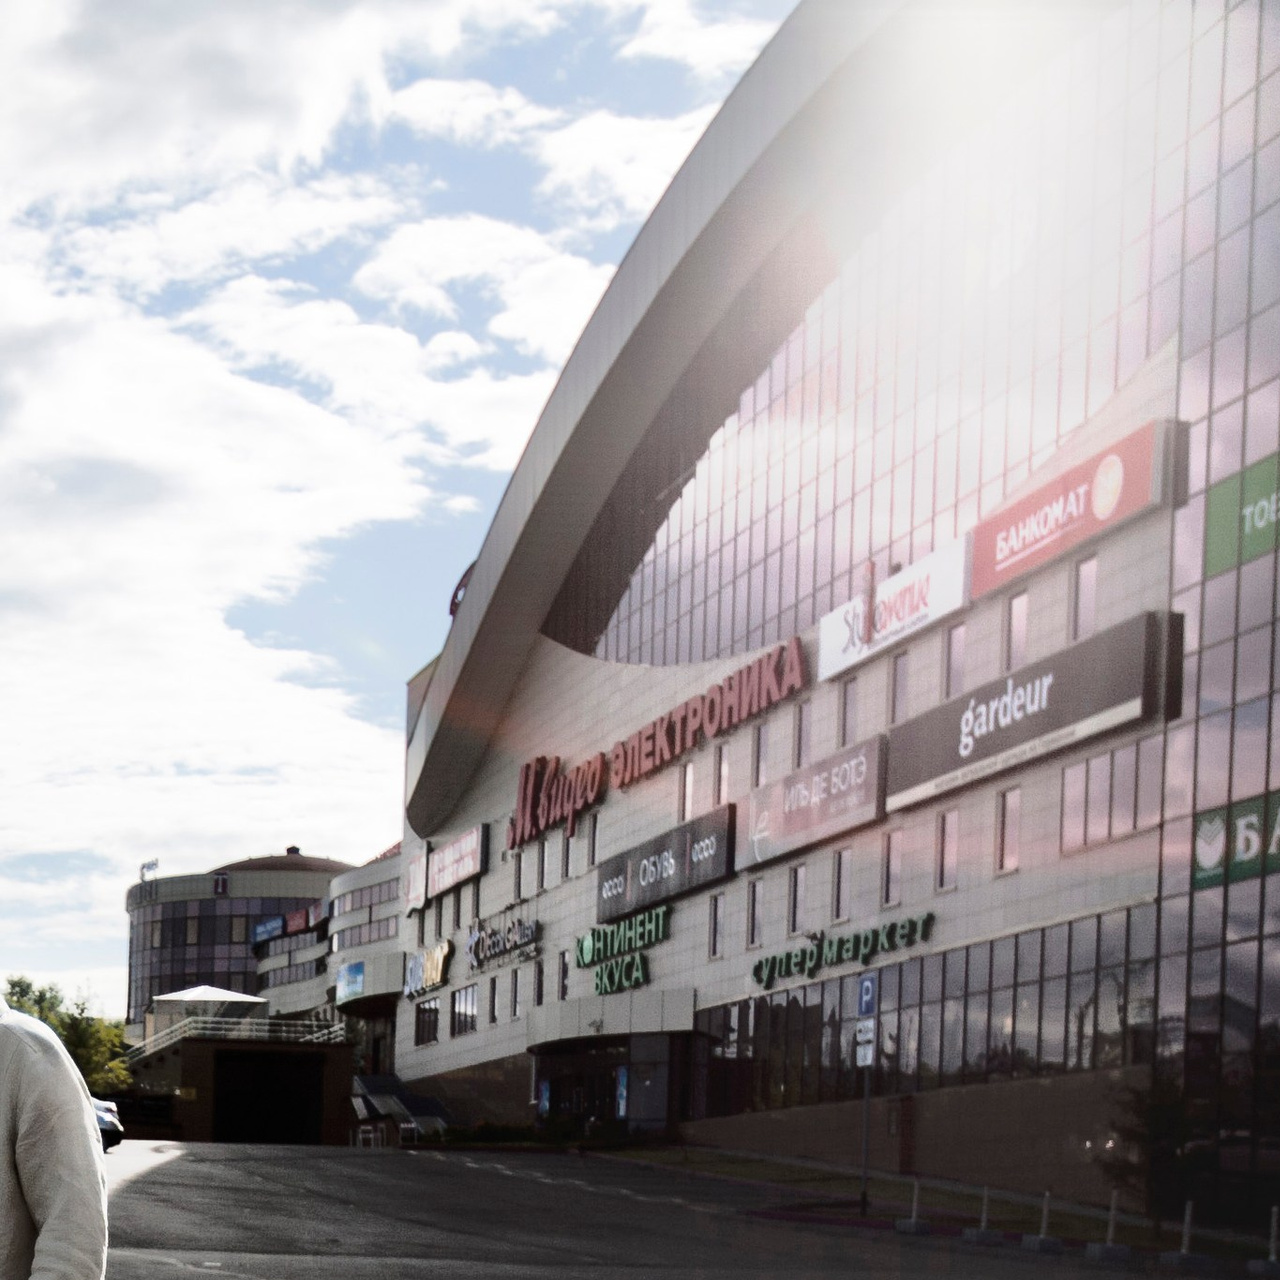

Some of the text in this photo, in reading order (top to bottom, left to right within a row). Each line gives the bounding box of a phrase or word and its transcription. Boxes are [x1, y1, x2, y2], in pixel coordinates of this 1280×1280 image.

[995, 484, 1090, 561] БАНКОМАТ
[610, 636, 802, 789] ЭЛЕКТРОНИКА
[958, 673, 1054, 757] gardeur
[602, 836, 717, 899] ecco ОБУВЬ ecco
[575, 905, 668, 969] КОНТИНЕНТ
[753, 913, 932, 989] супермаркет
[594, 951, 644, 996] ВКУСА
[861, 980, 872, 1012] P
